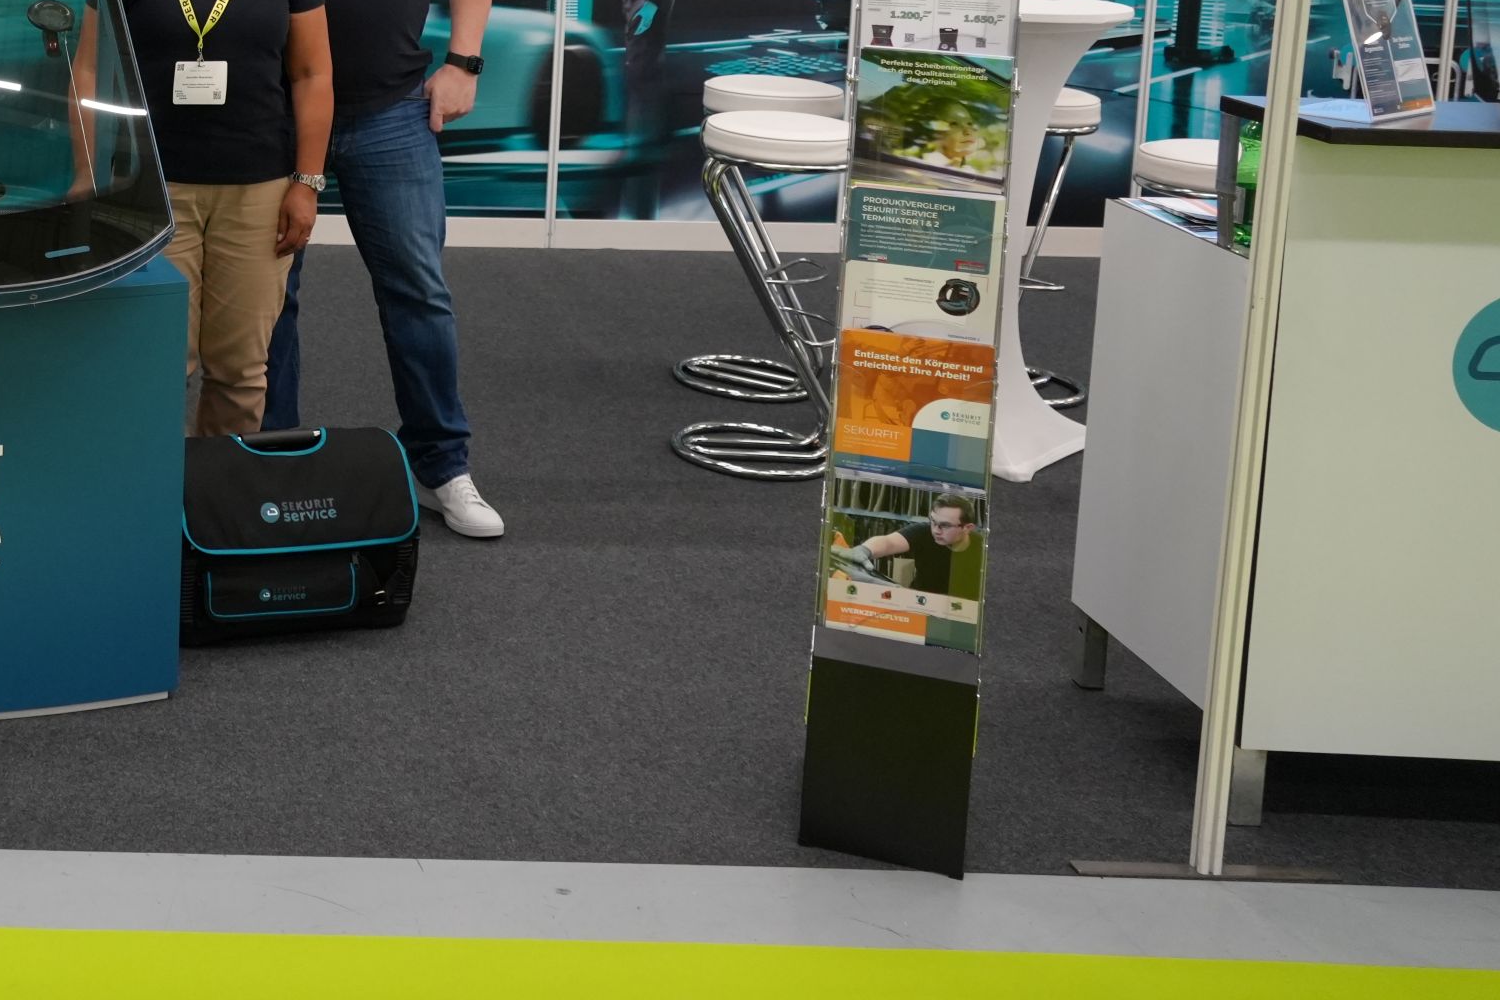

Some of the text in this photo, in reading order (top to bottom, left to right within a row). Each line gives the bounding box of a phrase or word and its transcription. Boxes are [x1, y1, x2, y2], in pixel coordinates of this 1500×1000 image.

[880, 58, 987, 74] Perfekte Scheibenmontage
[898, 67, 913, 75] den
[921, 77, 957, 87] Originals
[862, 204, 938, 219] SEKURIT SERVICE
[863, 195, 956, 212] PRODUKTVERGLEICH
[861, 213, 919, 227] TERMINATOR
[852, 359, 971, 382] erleichtert Ihre Arbeit!
[902, 355, 922, 366] den
[924, 357, 962, 372] Körper
[963, 363, 984, 374] und
[280, 497, 335, 513] SEKURIT
[283, 506, 337, 523] service
